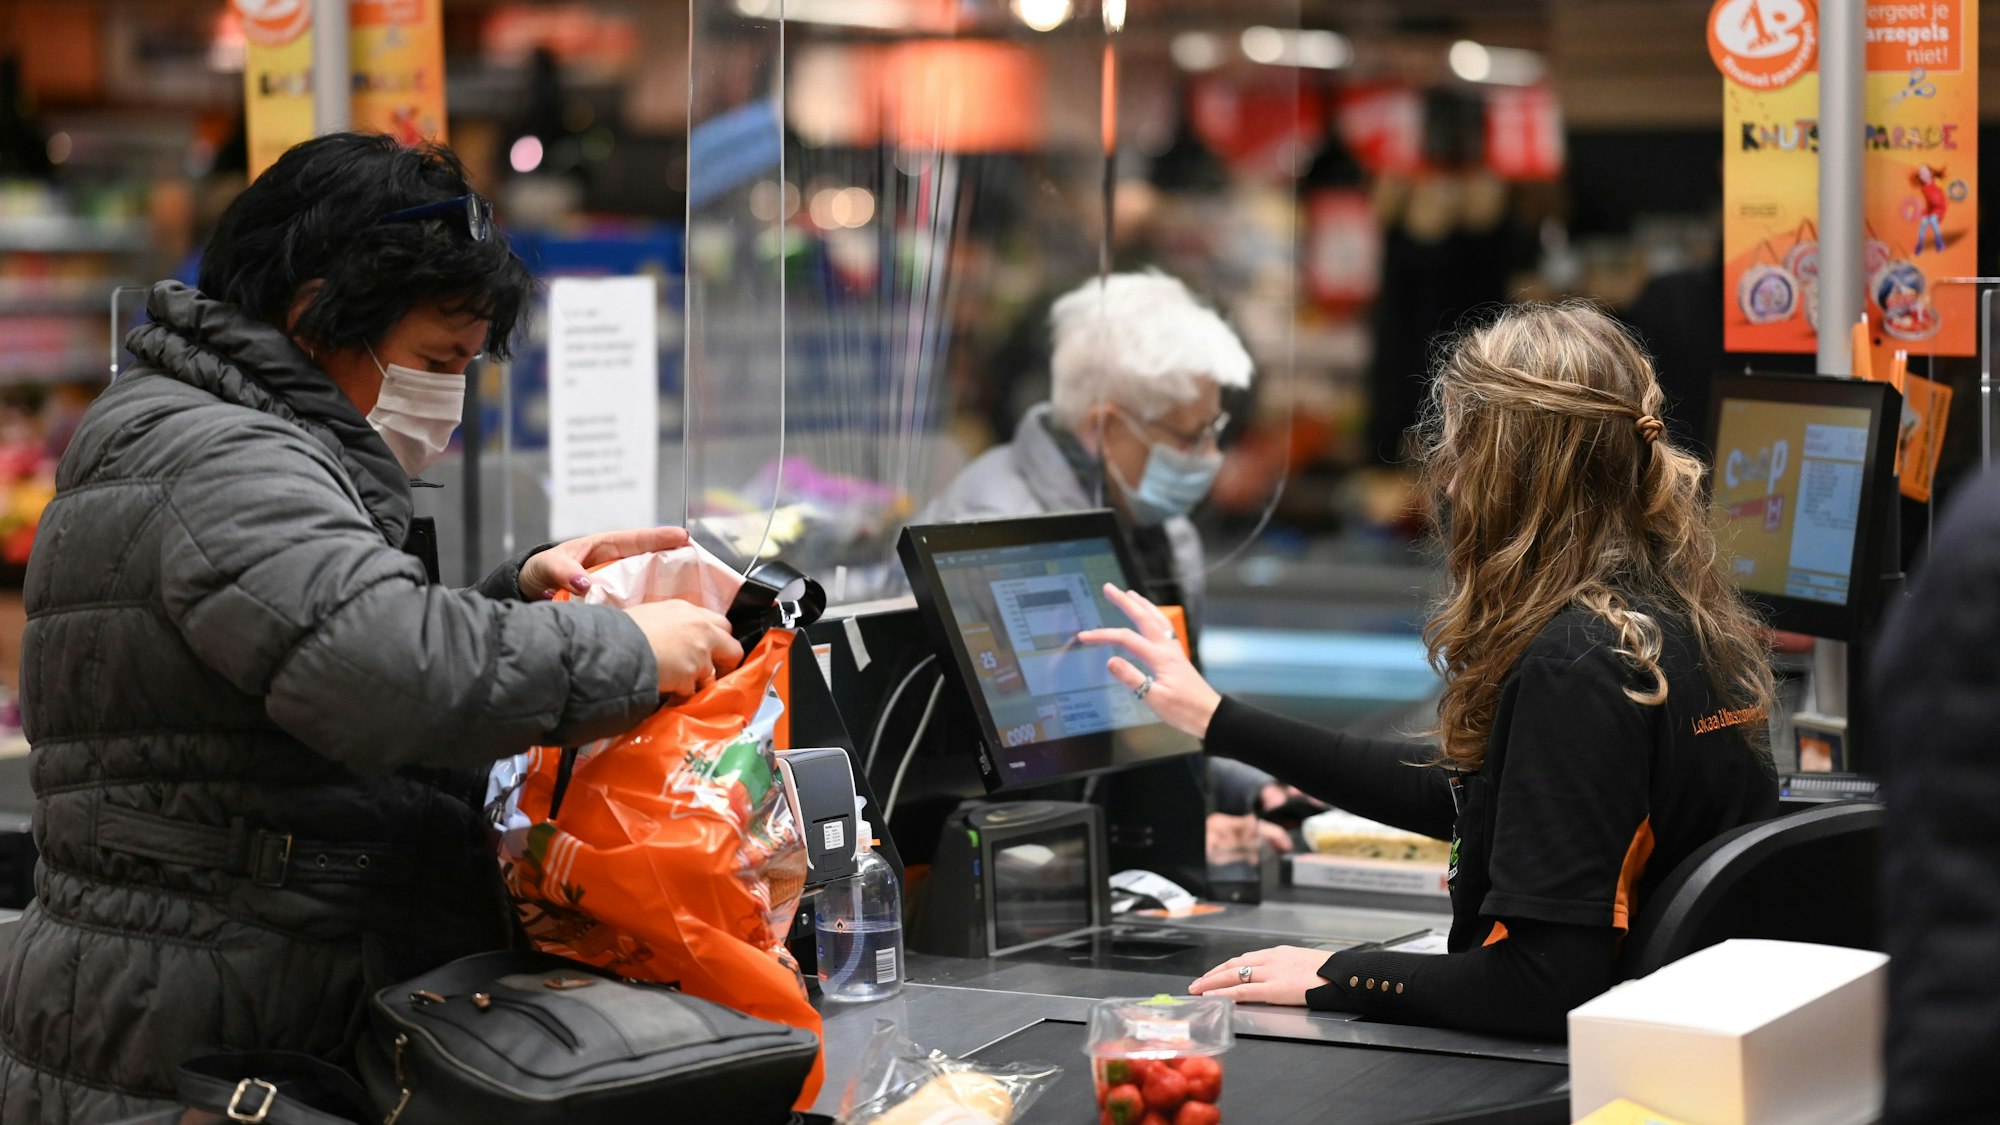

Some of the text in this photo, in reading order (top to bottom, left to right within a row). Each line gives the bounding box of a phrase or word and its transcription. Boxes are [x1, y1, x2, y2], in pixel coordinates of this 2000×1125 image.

[1866, 1, 1949, 25] ergeet je
[1864, 22, 1950, 46] arzegels
[1906, 46, 1949, 64] niet!
[1691, 710, 1720, 736] Lokaal
